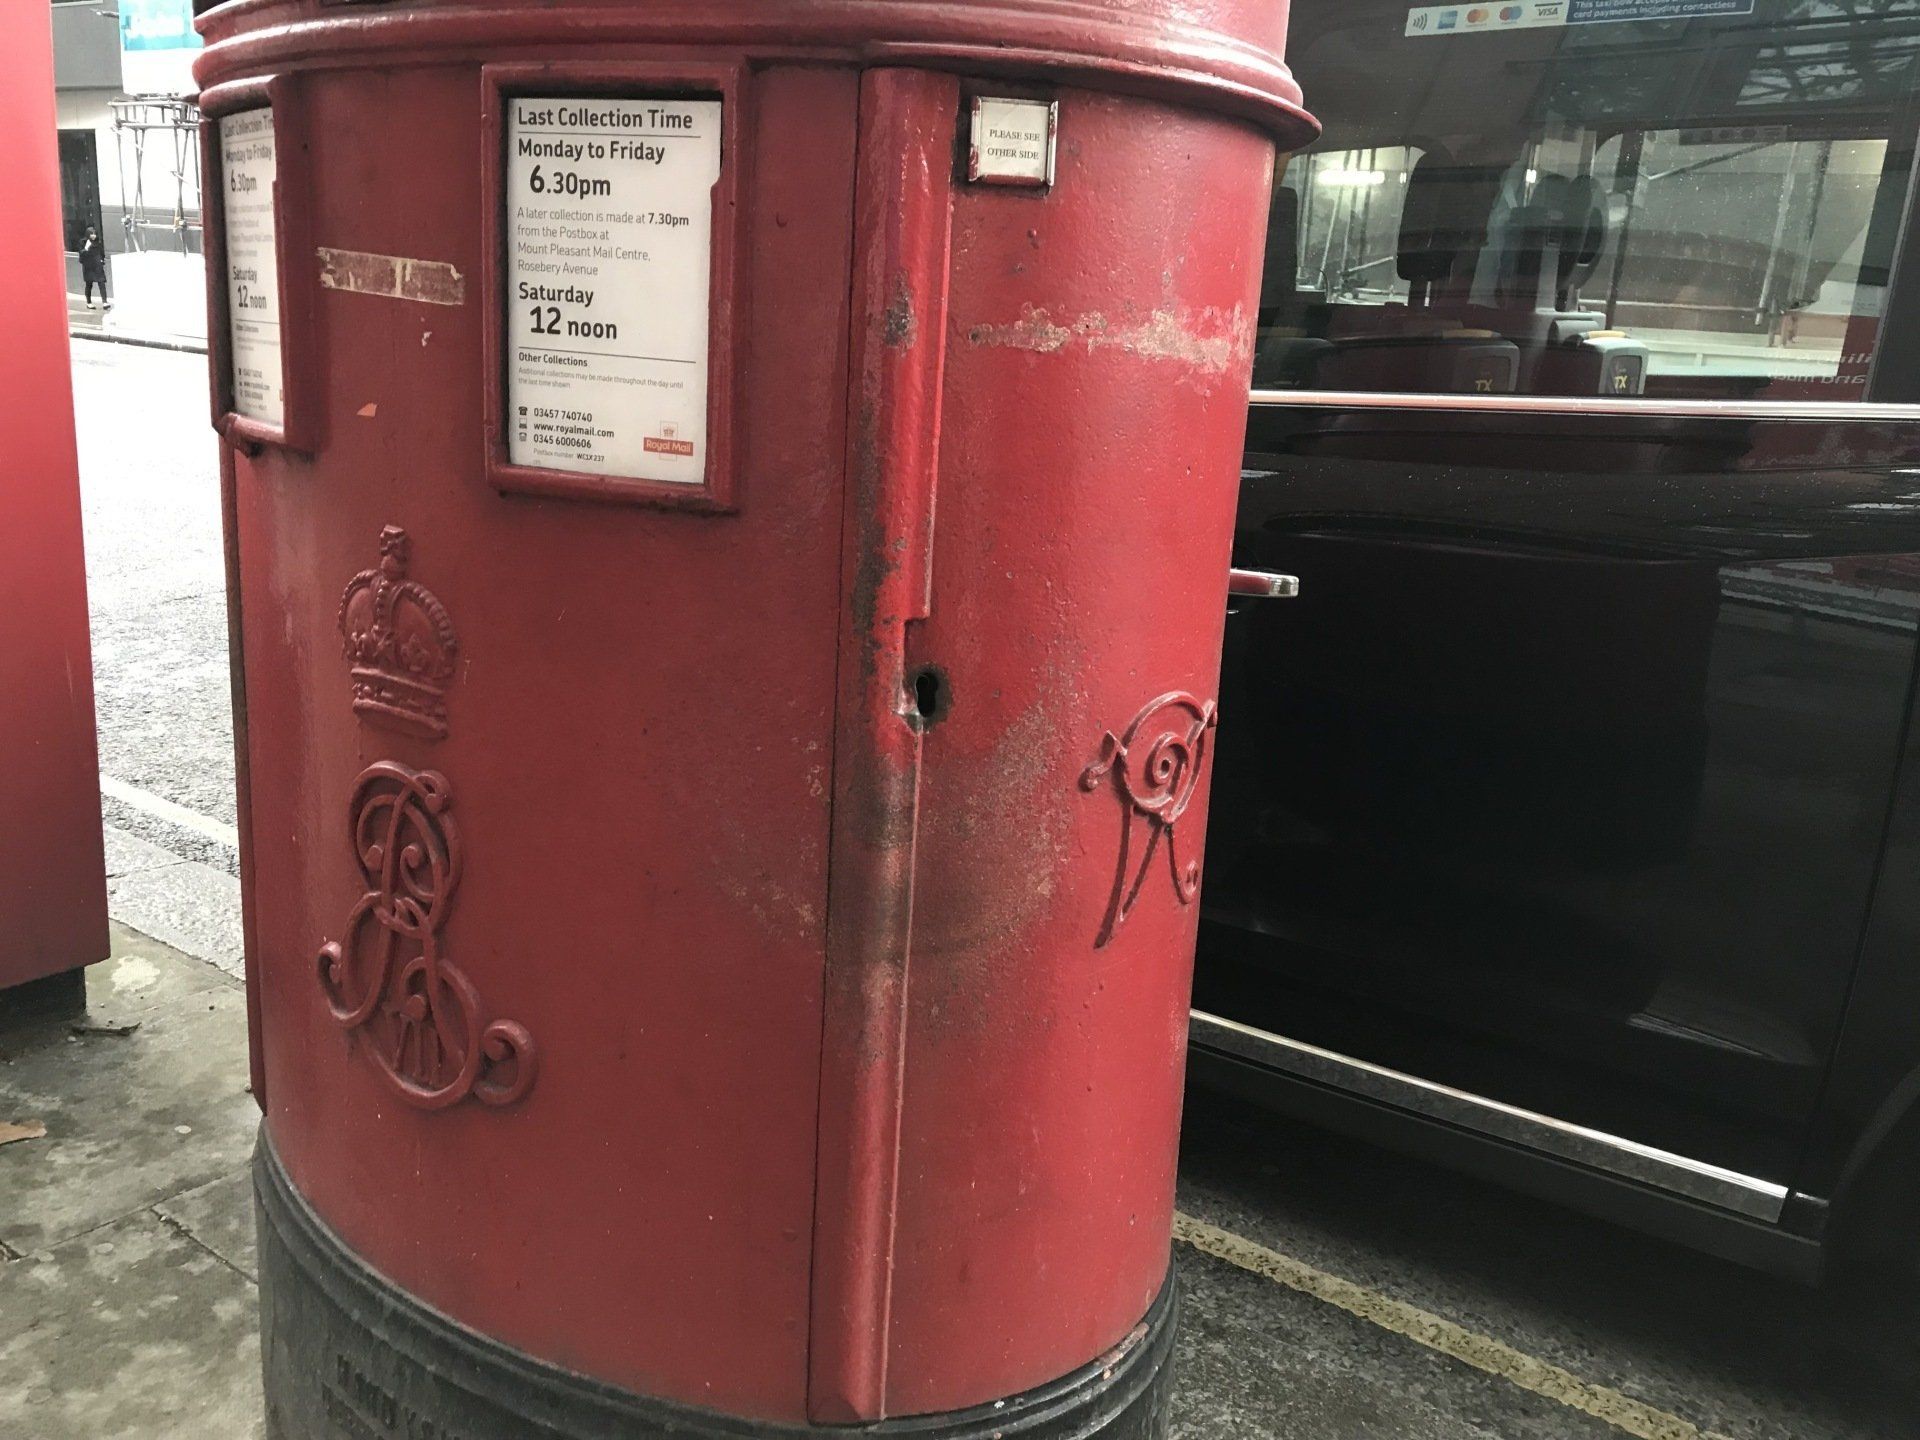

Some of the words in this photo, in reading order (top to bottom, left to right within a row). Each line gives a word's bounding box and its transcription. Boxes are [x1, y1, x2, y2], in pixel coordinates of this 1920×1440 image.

[1538, 7, 1558, 16] VISA
[1573, 10, 1593, 18] card
[1593, 8, 1637, 17] payments
[1682, 2, 1737, 11] contactless
[518, 107, 554, 126] Last
[558, 107, 643, 128] Collection
[647, 109, 693, 129] Time
[989, 128, 1022, 140] PLEASE
[1024, 132, 1041, 142] SEE
[253, 143, 272, 162] Friday
[518, 138, 583, 161] Monday
[588, 142, 604, 159] to
[609, 140, 665, 165] Friday
[987, 147, 1017, 158] OTHER
[1019, 149, 1039, 160] SIDE
[230, 169, 257, 195] 6.30pm
[529, 164, 611, 199] 6.30pm
[517, 207, 525, 218] A
[526, 207, 547, 219] later
[550, 208, 593, 221] collection
[596, 211, 603, 222] is
[606, 211, 633, 224] made
[636, 213, 645, 224] at
[648, 212, 689, 228] 7.30pm
[517, 225, 540, 237] from
[542, 226, 557, 238] the
[559, 226, 598, 240] Postbox
[600, 229, 609, 241] at
[518, 242, 548, 255] Mount
[550, 244, 591, 258] Pleasant
[593, 245, 613, 259] Mail
[615, 247, 651, 262] Centre,
[518, 258, 560, 275] Rosebery
[562, 261, 598, 275] Avenue
[233, 266, 258, 284] Saturday
[237, 285, 248, 308] 12
[250, 295, 267, 309] noon
[518, 282, 594, 307] Saturday
[529, 305, 561, 335] 12
[567, 319, 617, 339] noon
[518, 351, 542, 364] Other
[543, 353, 588, 367] Collections
[575, 373, 587, 382] may
[614, 376, 646, 386] throughout
[657, 379, 668, 389] day
[1475, 379, 1493, 392] TX
[1615, 375, 1628, 389] TX
[533, 407, 559, 419] 03457
[561, 409, 593, 423] 740740
[533, 422, 615, 438] www.royalmail.com
[533, 433, 554, 445] 0345
[555, 436, 592, 449] 6000606
[646, 439, 670, 452] Royal
[671, 442, 691, 453] Mail
